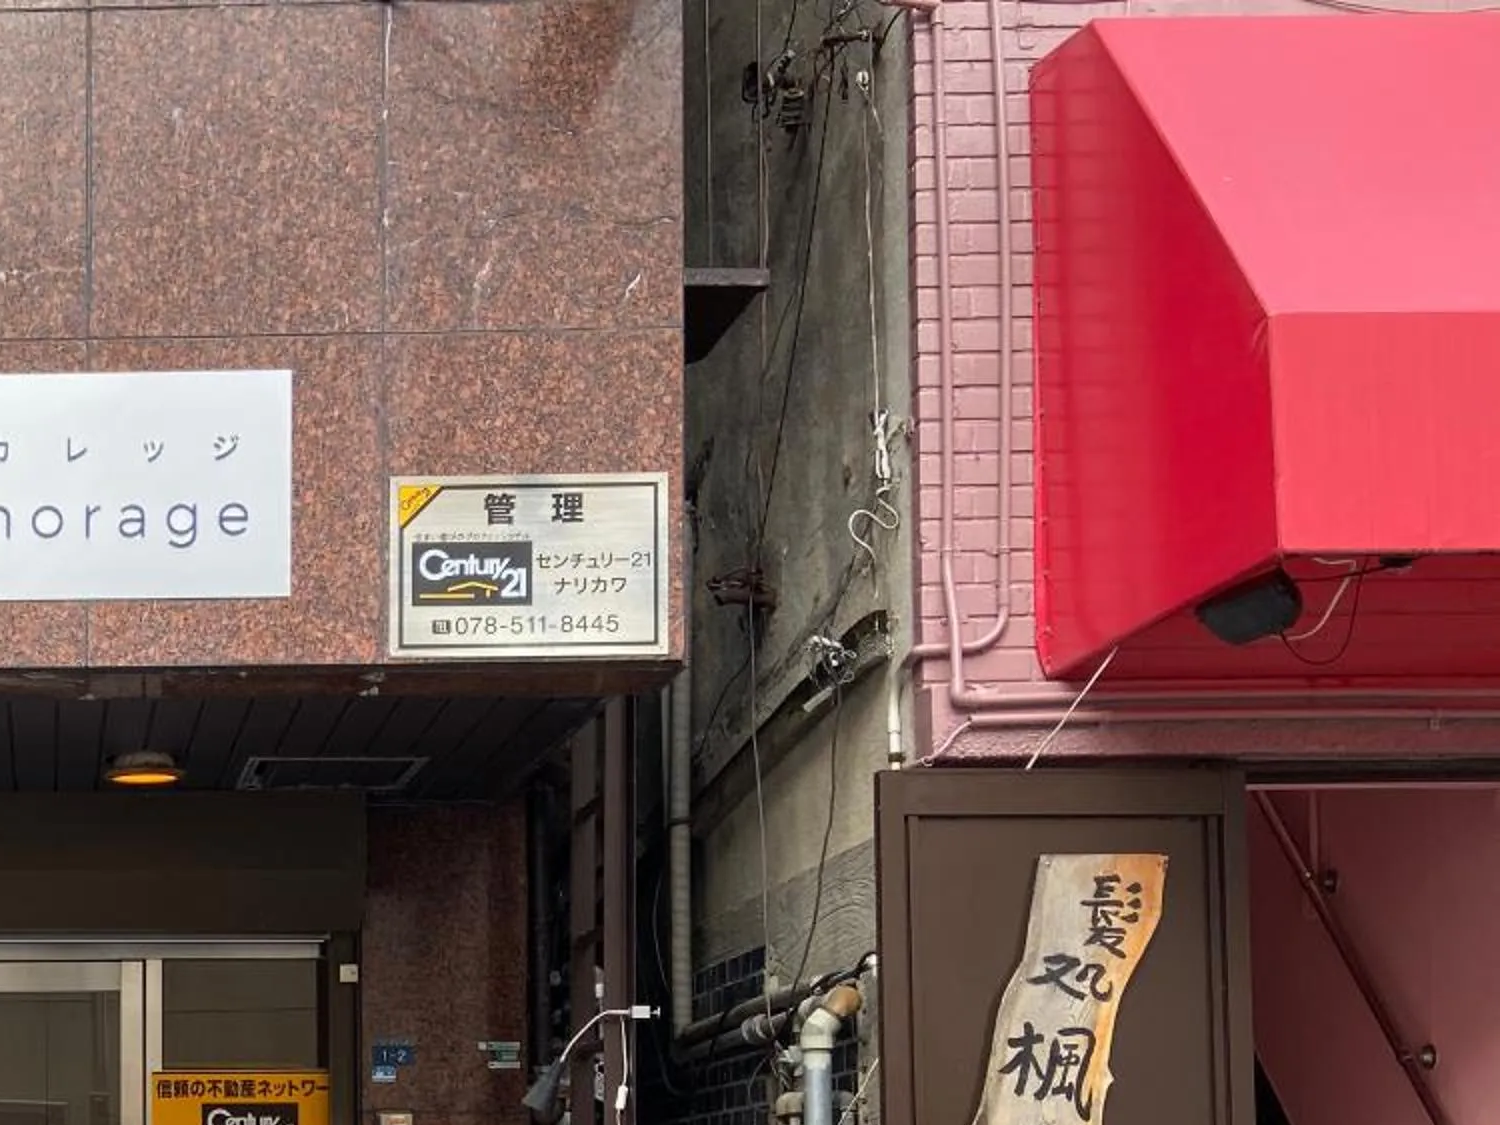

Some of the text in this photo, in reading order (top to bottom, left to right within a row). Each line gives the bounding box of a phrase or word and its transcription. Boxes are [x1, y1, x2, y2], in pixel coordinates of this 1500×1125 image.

[484, 492, 584, 525] 管理
[536, 552, 652, 569] センチュリー21
[554, 577, 627, 595] ナリカワ
[455, 615, 620, 635] 078-511-8445
